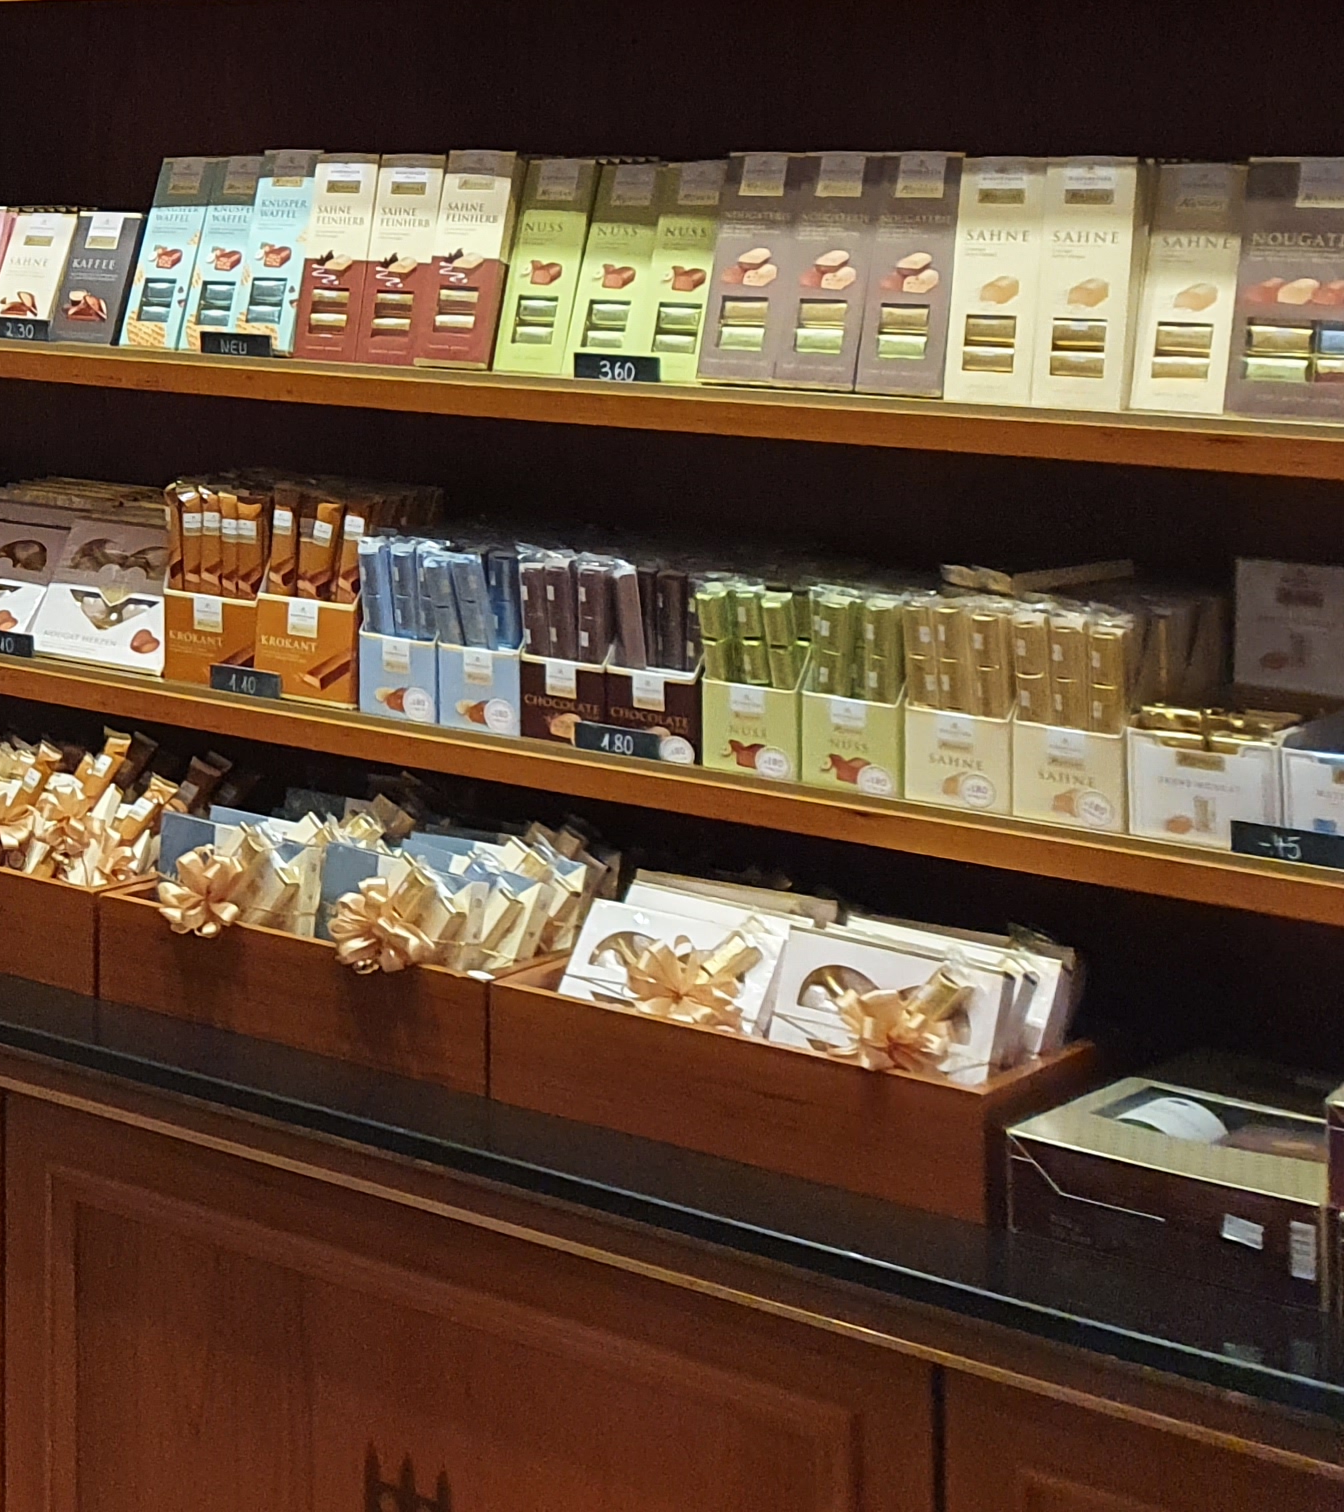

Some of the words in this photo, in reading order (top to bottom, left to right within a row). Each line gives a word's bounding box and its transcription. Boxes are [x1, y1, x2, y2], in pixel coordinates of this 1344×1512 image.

[261, 198, 308, 209] KNUSPER
[316, 205, 352, 215] SAHNE
[447, 202, 485, 212] SAHNE
[381, 206, 417, 216] SAHNE
[316, 216, 364, 226] FEINHERB
[380, 218, 430, 228] FEINHERB
[445, 213, 498, 224] FEINHERB
[524, 221, 564, 233] NUSS
[597, 225, 638, 237] NUSS
[665, 226, 707, 238] NUSS
[967, 229, 1031, 243] SAHNE
[1052, 230, 1120, 244] SAHNE
[1162, 235, 1233, 250] SAHNE
[72, 258, 116, 271] KAFFEE
[220, 338, 248, 355] NEU
[169, 630, 223, 648] KROKANT
[261, 635, 317, 652] KROKANT
[524, 693, 600, 716] CHOCOLATE
[611, 706, 689, 727] CHOCOLATE
[728, 725, 767, 738] NUSS
[829, 738, 869, 752] NUSS
[928, 752, 983, 770] SAHNE
[1037, 768, 1096, 787] SAHNE
